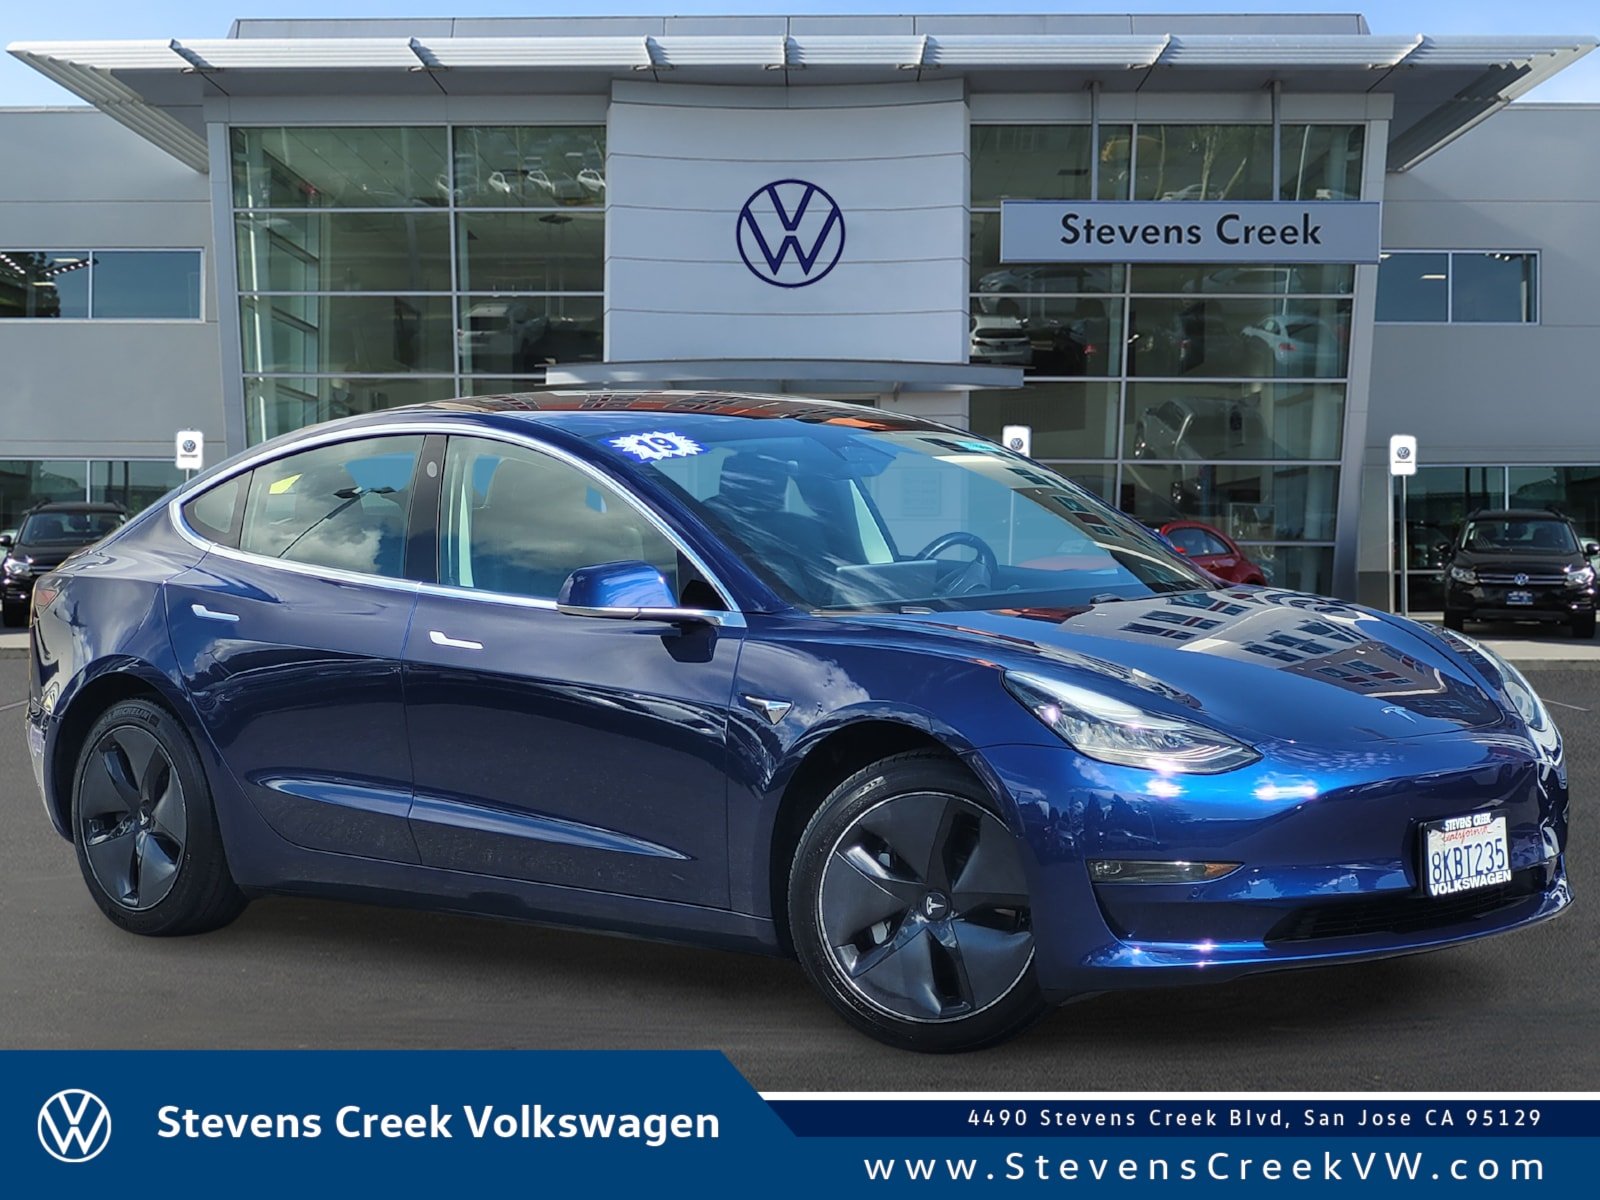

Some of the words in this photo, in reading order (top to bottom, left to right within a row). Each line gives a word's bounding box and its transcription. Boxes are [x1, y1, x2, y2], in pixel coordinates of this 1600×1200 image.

[1060, 213, 1202, 245] Stevens
[1216, 212, 1322, 245] Creek
[1444, 816, 1473, 832] STEVENS
[1431, 838, 1505, 885] 8KBT235
[1430, 869, 1512, 896] VOLKSWAGEN
